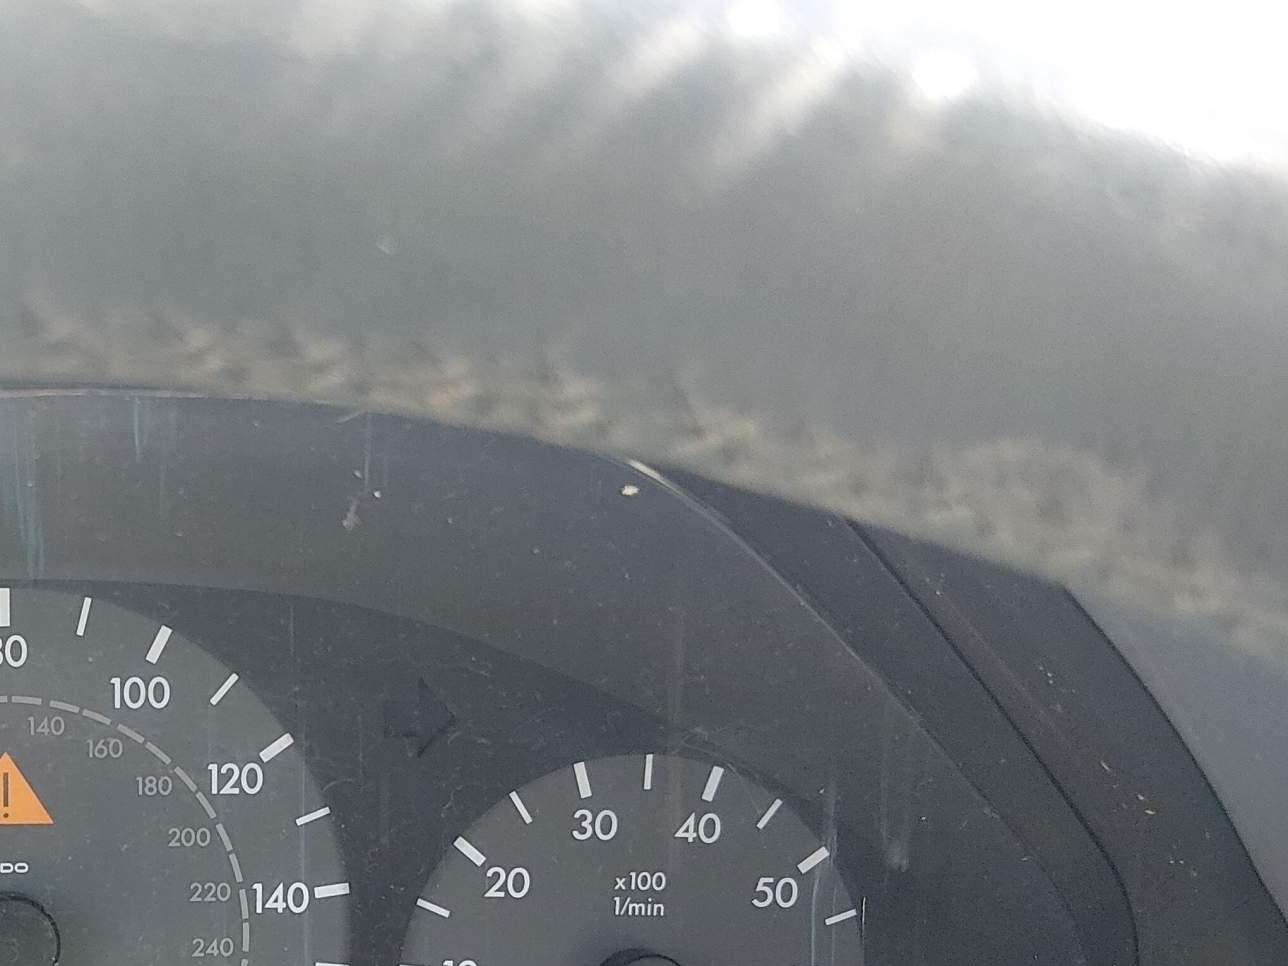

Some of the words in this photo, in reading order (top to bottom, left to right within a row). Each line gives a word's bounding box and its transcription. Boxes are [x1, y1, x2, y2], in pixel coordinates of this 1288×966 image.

[111, 677, 170, 709] 100
[28, 716, 64, 737] 140
[86, 738, 123, 758] 160
[137, 776, 172, 796] 180
[208, 762, 263, 795] 120
[572, 809, 617, 841] 30
[674, 813, 722, 844] 40
[168, 827, 210, 847] 200
[485, 866, 530, 899] 20
[615, 871, 666, 891] x100
[190, 883, 230, 903] 220
[252, 882, 309, 913] 140
[752, 877, 798, 908] 50
[614, 897, 664, 916] 1/min
[192, 937, 233, 957] 240
